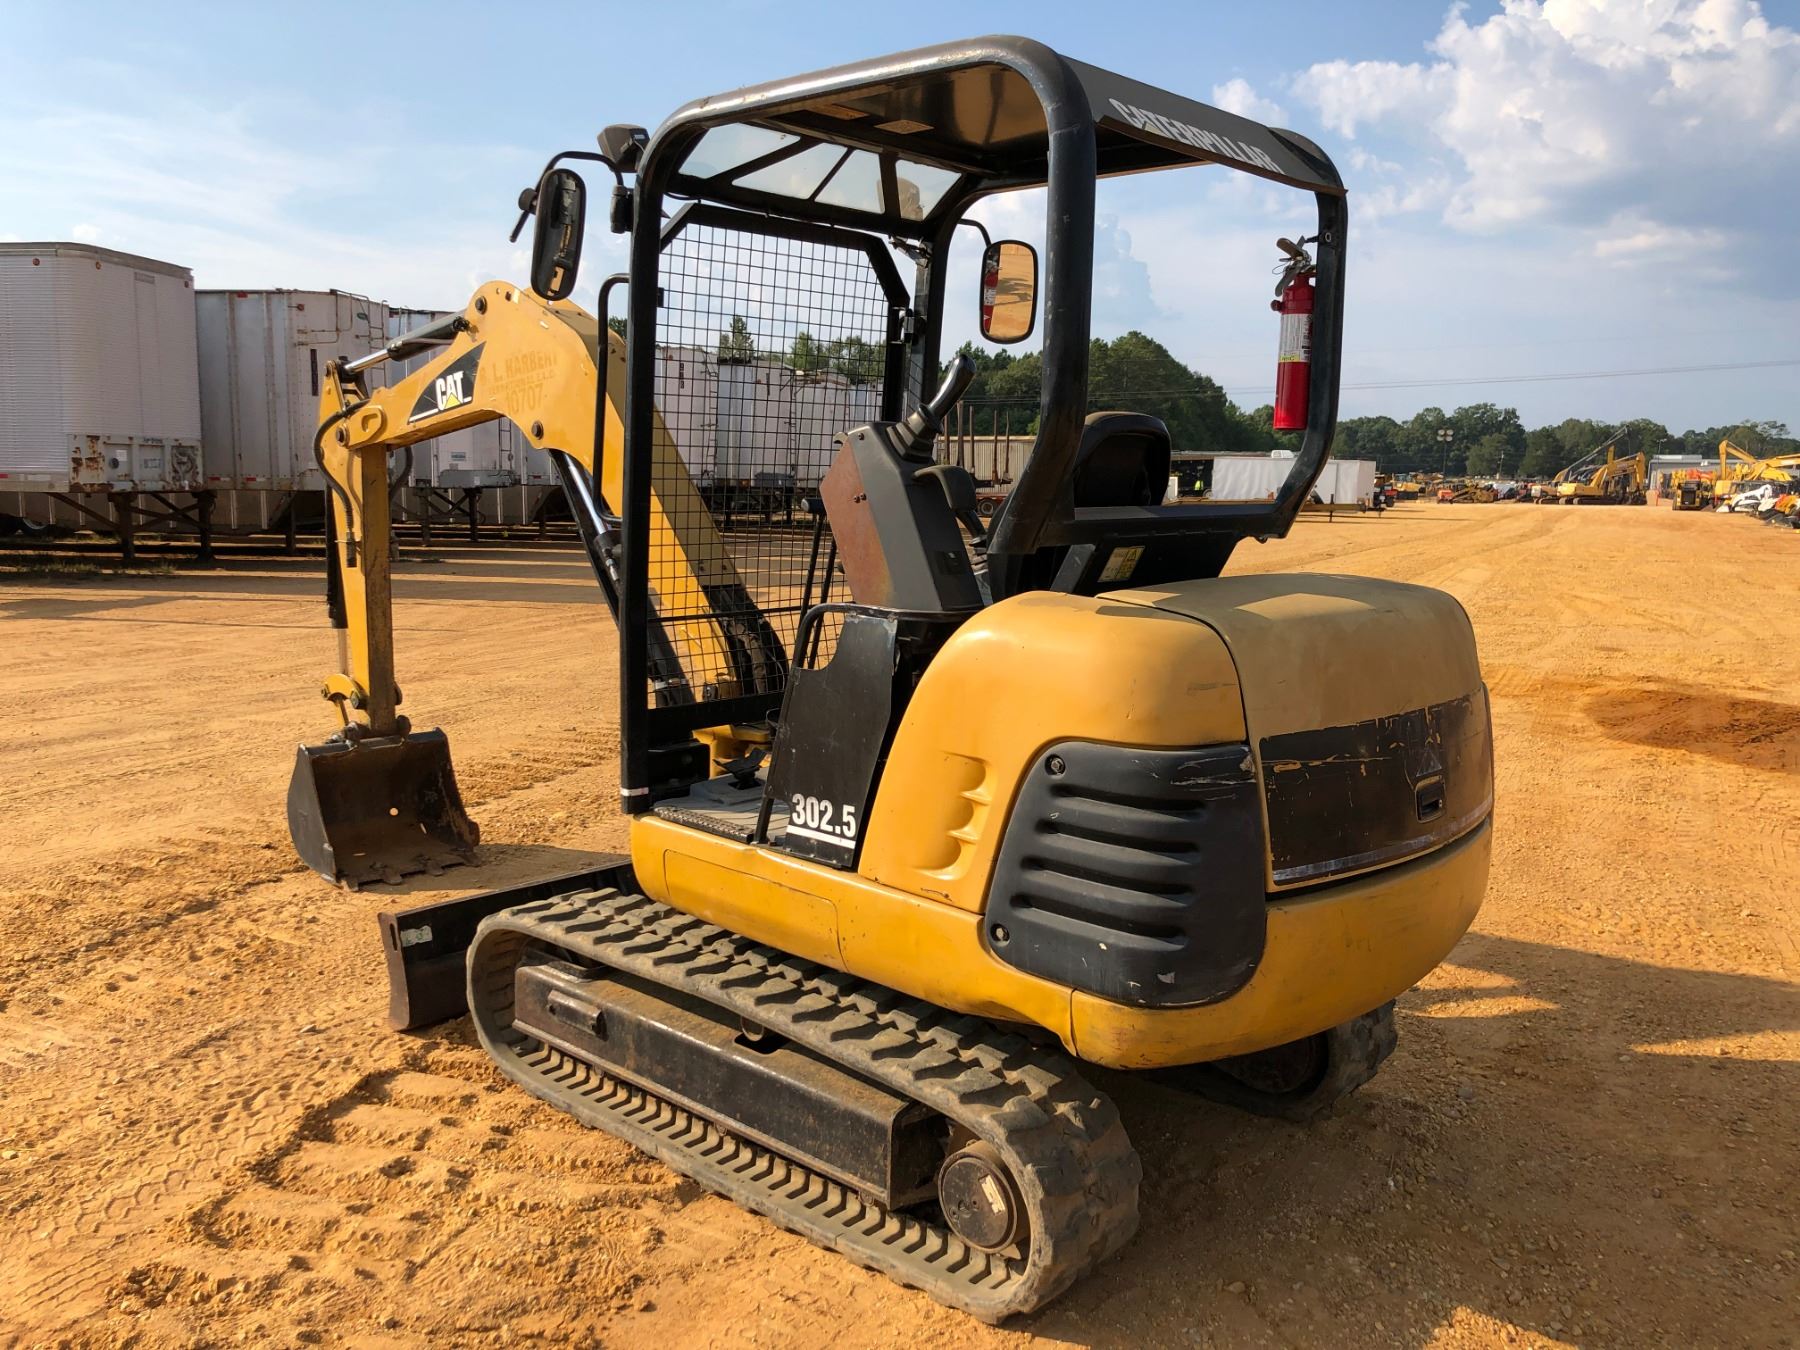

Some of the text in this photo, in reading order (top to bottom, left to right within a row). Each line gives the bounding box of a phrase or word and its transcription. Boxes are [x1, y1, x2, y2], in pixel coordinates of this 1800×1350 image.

[1108, 97, 1287, 175] CATERPILLAR
[435, 370, 467, 411] CAT
[506, 382, 544, 415] 10707
[792, 793, 857, 838] 302.5
